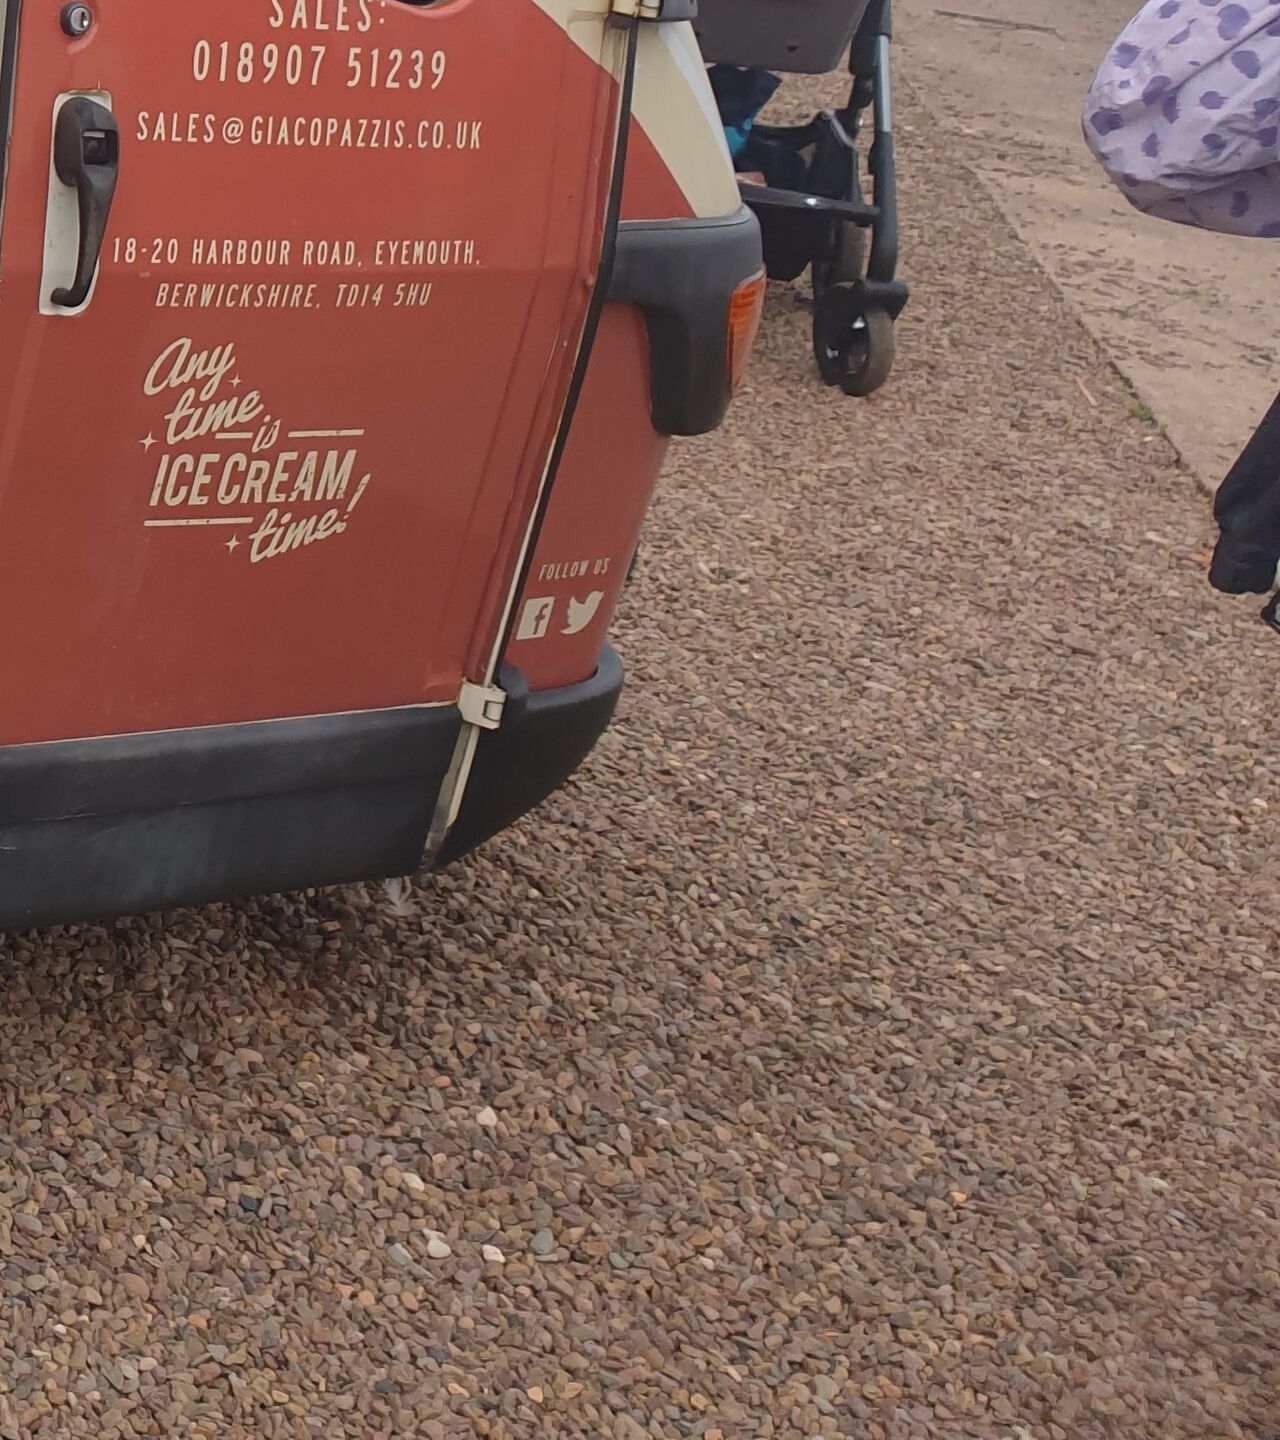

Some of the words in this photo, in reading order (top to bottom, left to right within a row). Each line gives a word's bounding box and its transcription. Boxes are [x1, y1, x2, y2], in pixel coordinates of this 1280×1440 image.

[193, 40, 326, 86] 018907
[346, 47, 447, 90] 51239
[136, 111, 483, 150] SALES@GIACOPAZZIS.CO.UK
[112, 237, 179, 264] 18-20
[191, 239, 291, 266] HARBOUR
[335, 283, 385, 308] TD14
[393, 283, 433, 307] 5HU
[143, 336, 236, 402] Any
[164, 387, 264, 446] time
[251, 414, 281, 453] is
[539, 561, 590, 581] FOLLOW
[593, 558, 610, 575] US
